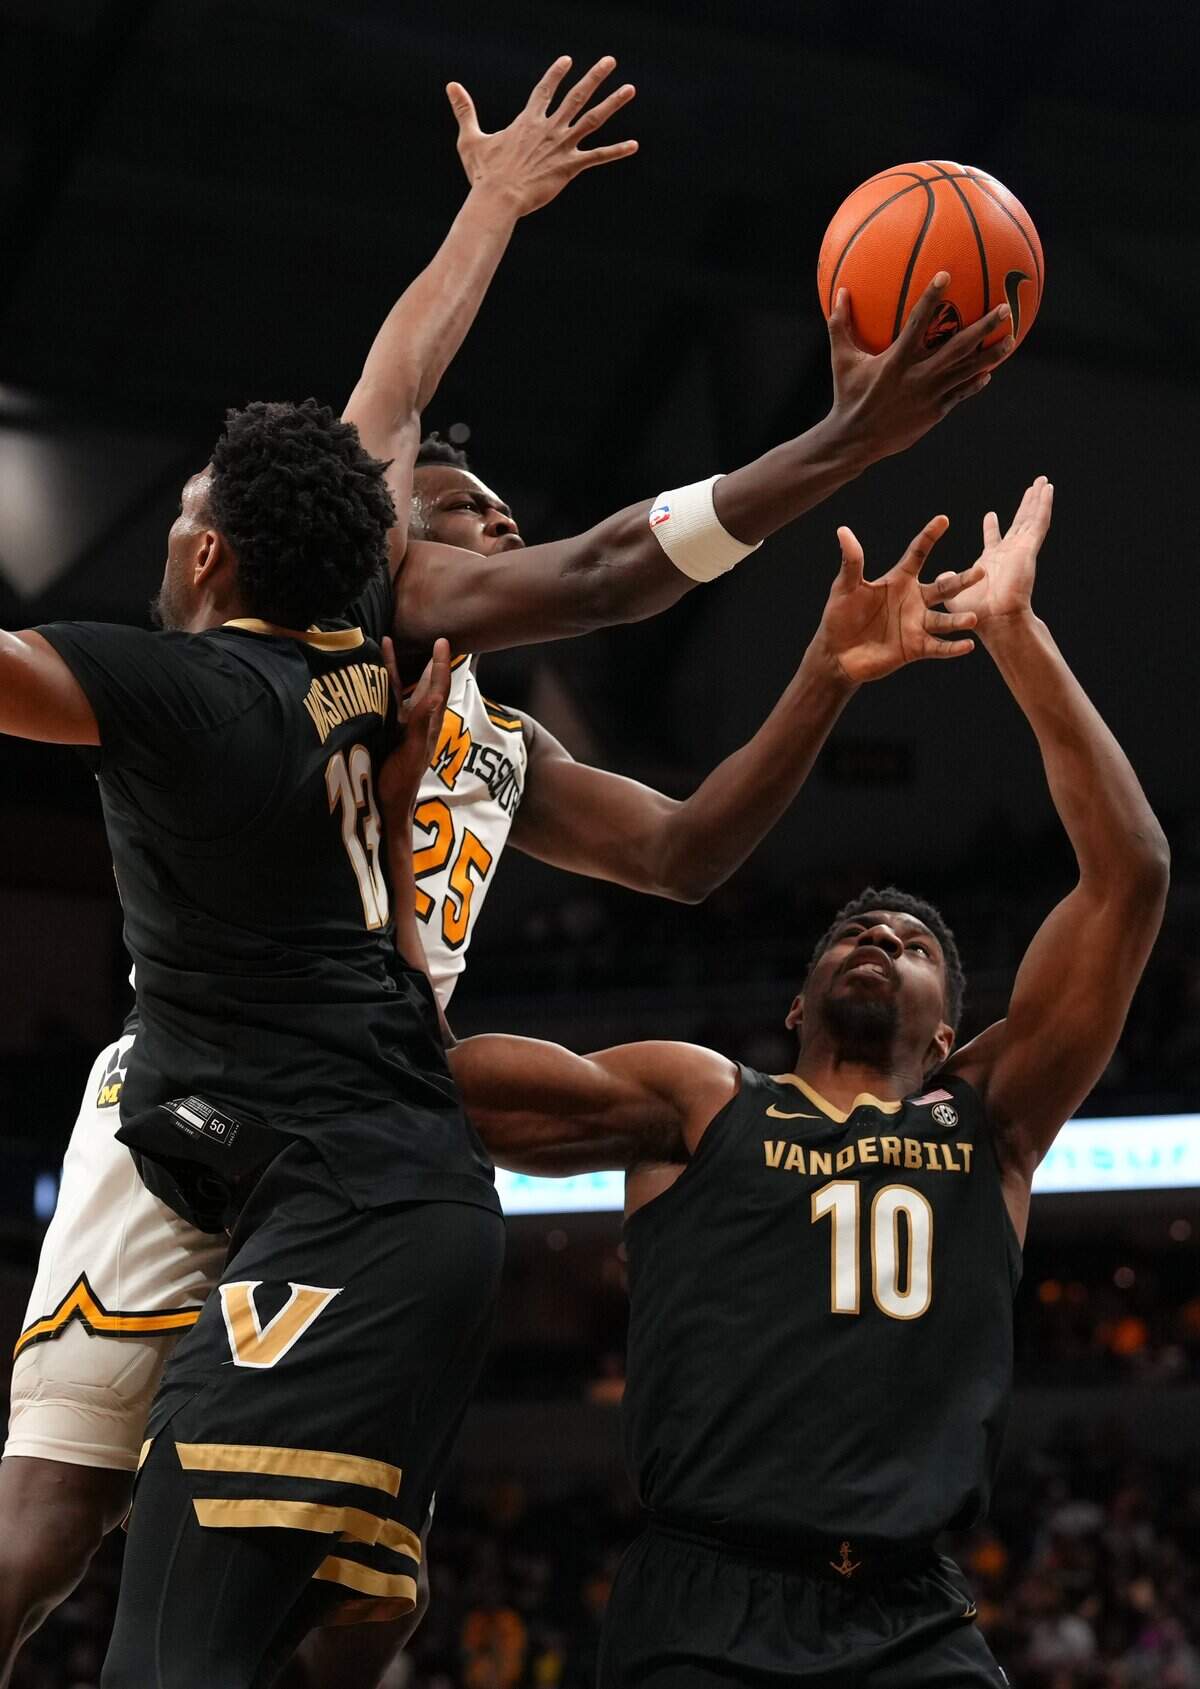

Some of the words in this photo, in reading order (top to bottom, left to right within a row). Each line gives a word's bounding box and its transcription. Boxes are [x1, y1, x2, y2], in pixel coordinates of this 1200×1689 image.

[325, 744, 390, 932] 13
[414, 797, 493, 952] 25
[209, 1118, 227, 1136] 50
[763, 1136, 974, 1176] VANDERBILT
[933, 1105, 956, 1125] SEC
[811, 1179, 934, 1321] 10
[219, 1280, 344, 1369] V
